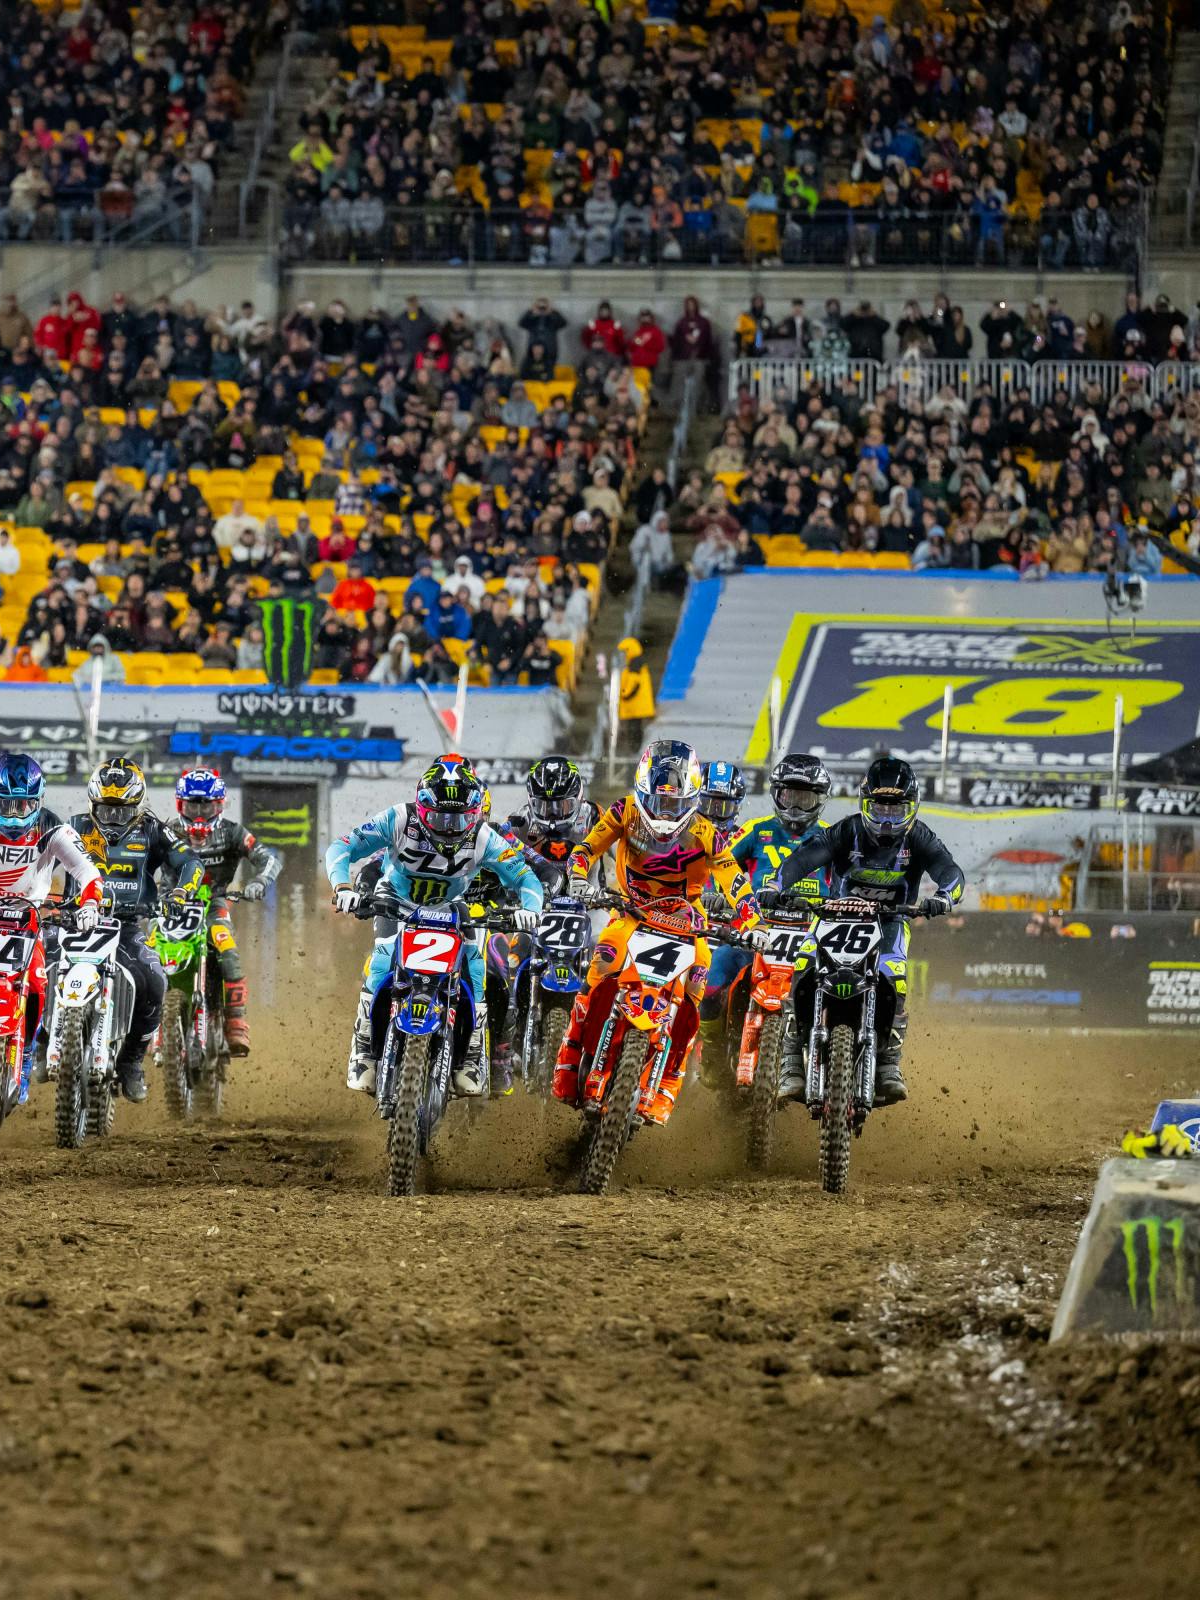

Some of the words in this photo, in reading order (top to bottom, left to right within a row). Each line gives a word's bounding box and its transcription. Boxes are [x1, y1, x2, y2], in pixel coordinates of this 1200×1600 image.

[220, 694, 346, 716] MONSTER
[816, 674, 1184, 736] 18
[398, 847, 476, 876] FLY
[850, 886, 897, 901] KTM
[419, 908, 452, 922] PROTAPER
[62, 928, 119, 952] 27
[538, 915, 585, 947] 28
[819, 924, 876, 954] 46
[404, 932, 455, 973] 2
[635, 942, 683, 977] 4
[440, 1040, 451, 1093] DUNLOP
